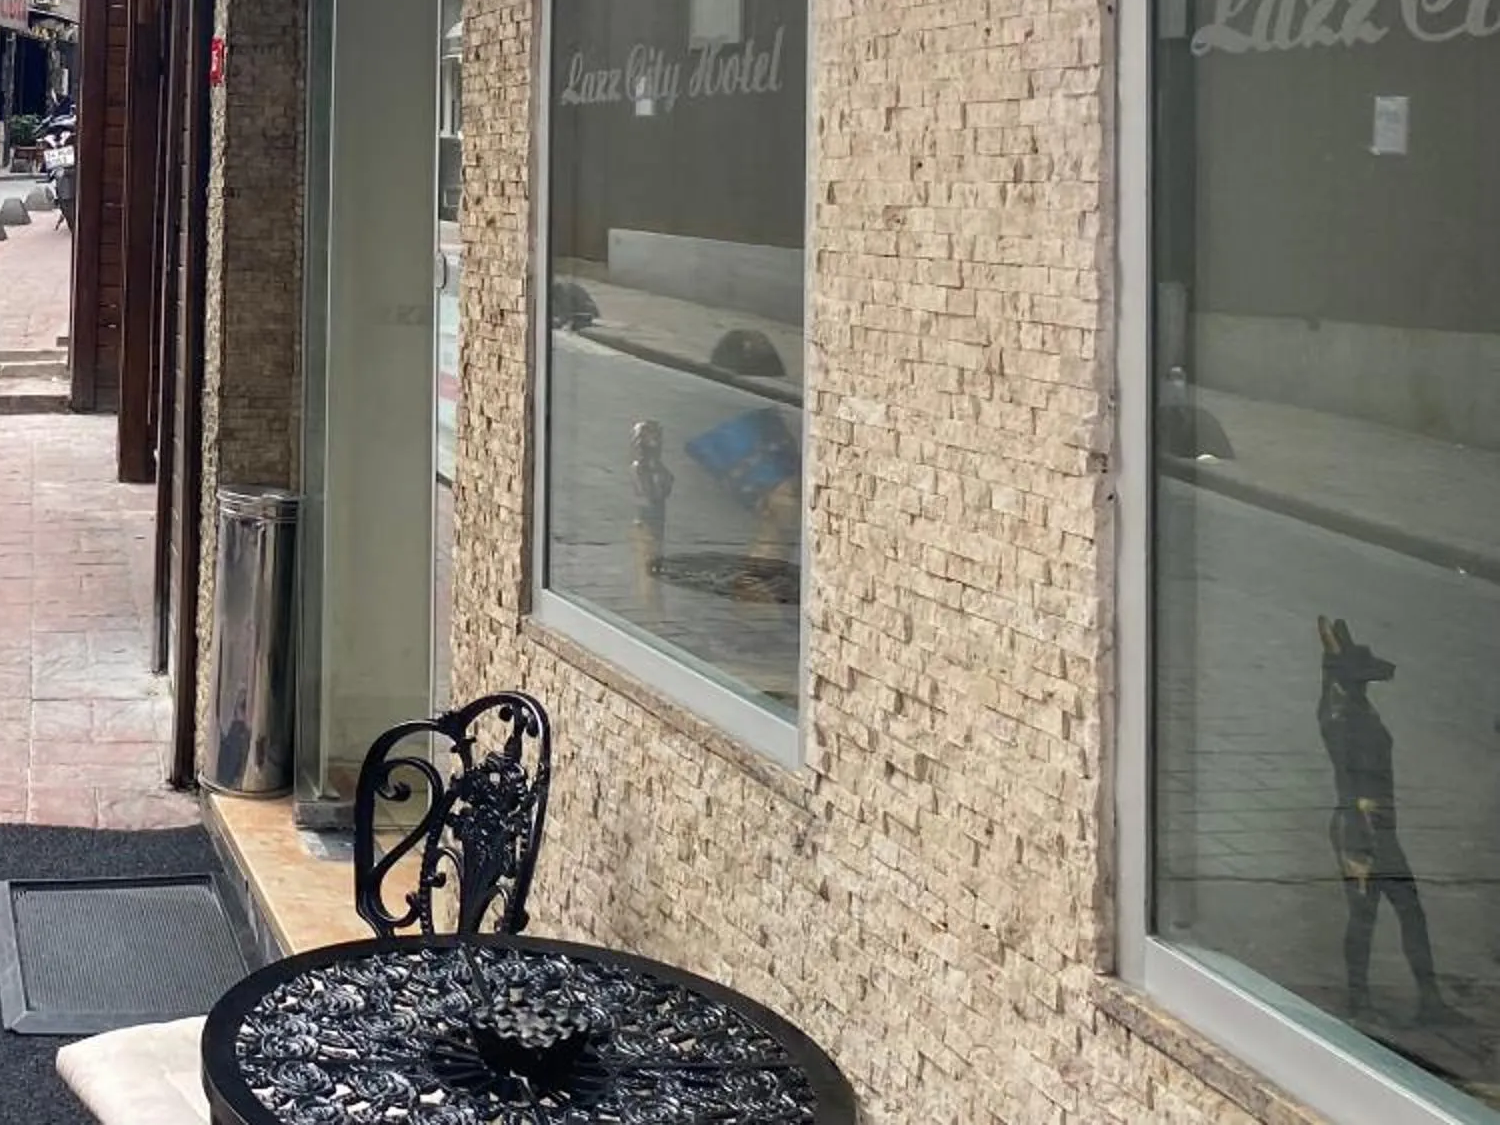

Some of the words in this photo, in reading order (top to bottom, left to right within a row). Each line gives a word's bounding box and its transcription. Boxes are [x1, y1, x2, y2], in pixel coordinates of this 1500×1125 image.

[561, 52, 622, 106] Lazz
[625, 43, 681, 113] City
[688, 25, 784, 98] Hotel
